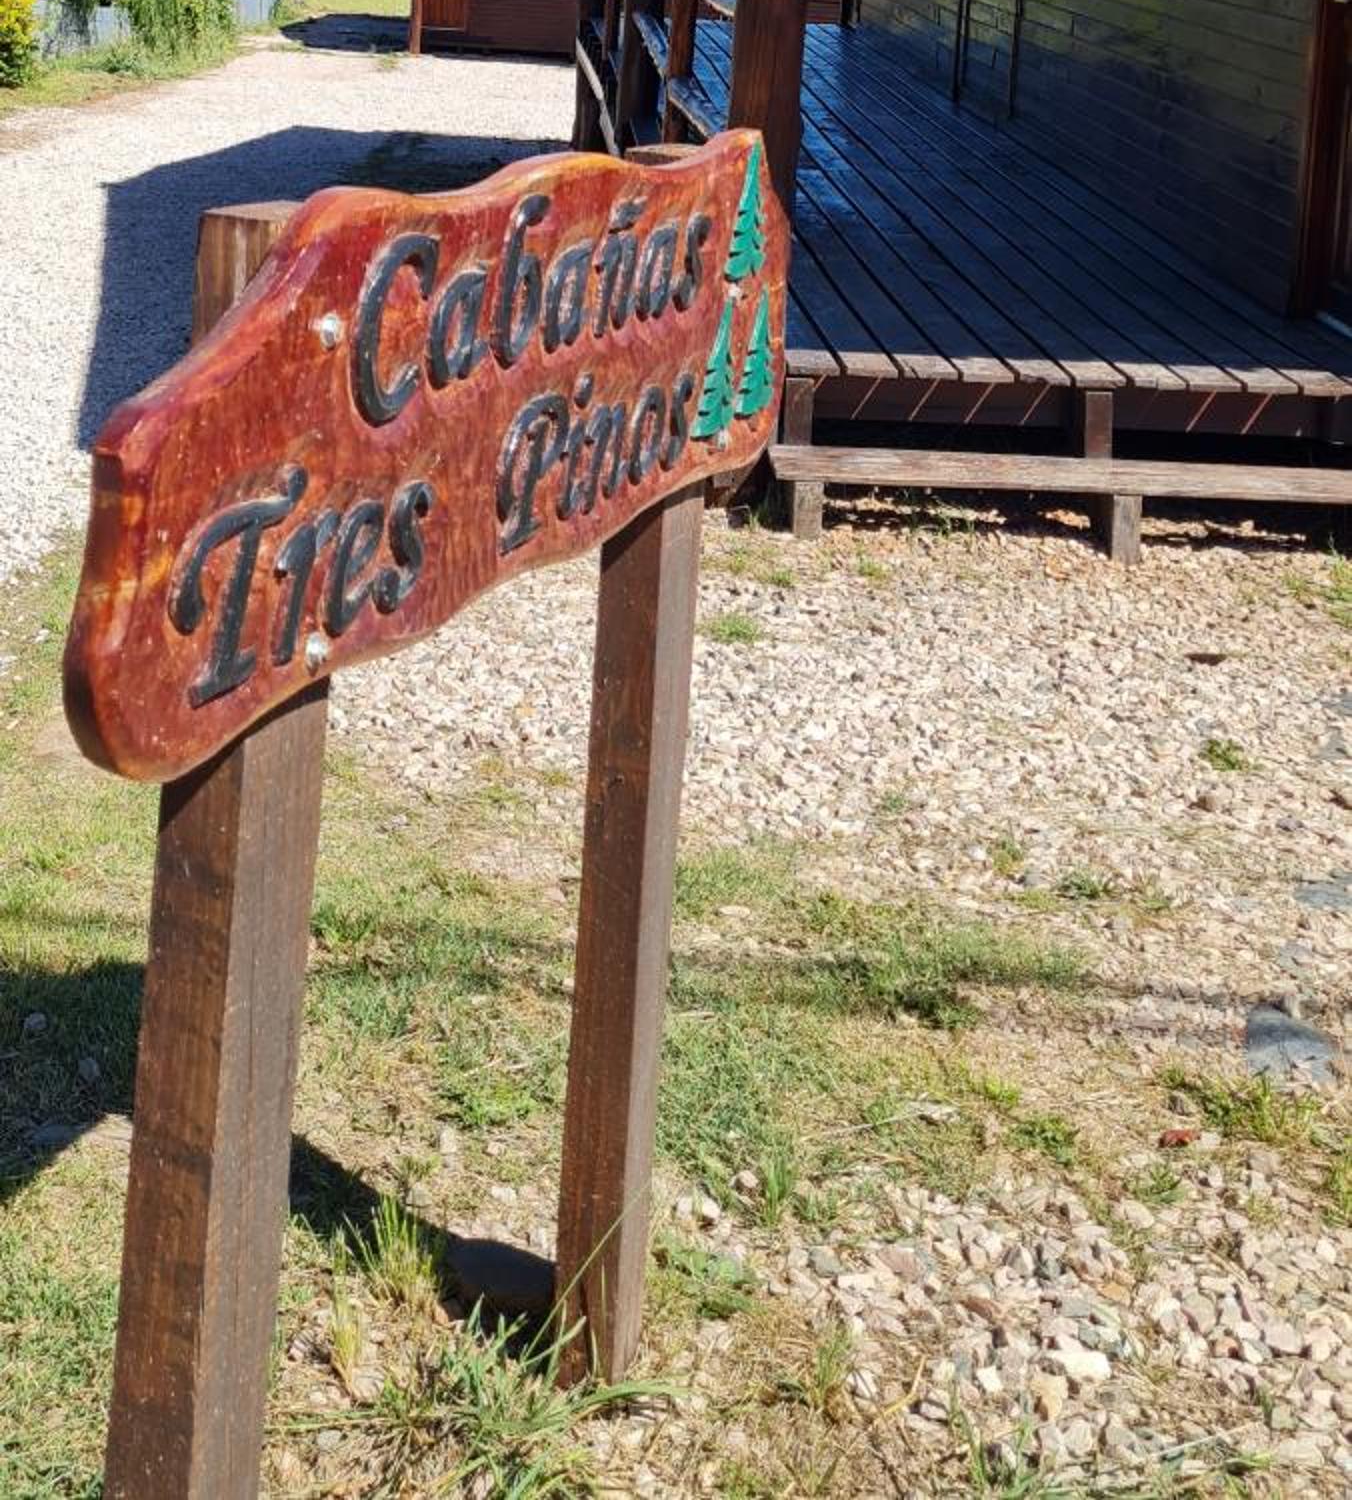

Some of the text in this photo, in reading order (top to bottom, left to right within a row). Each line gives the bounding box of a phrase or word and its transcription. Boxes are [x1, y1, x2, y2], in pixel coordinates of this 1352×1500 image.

[352, 194, 709, 426] Cabañas
[170, 372, 693, 708] Tres Pinos
